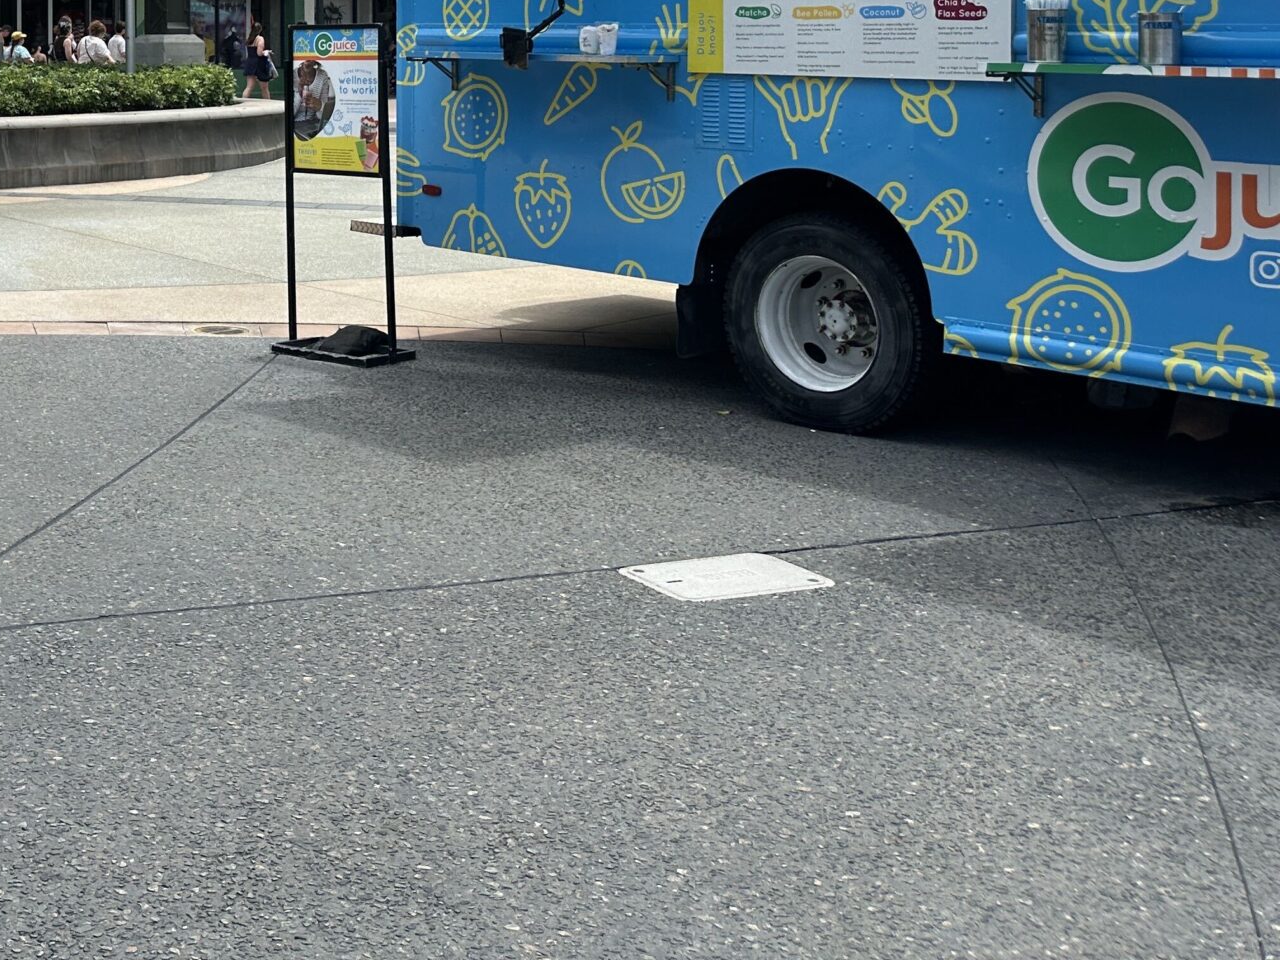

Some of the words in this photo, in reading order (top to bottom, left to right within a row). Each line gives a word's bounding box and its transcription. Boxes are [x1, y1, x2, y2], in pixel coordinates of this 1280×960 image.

[738, 9, 768, 17] Matcha
[796, 9, 811, 17] Bee
[813, 8, 838, 17] Pollen
[862, 7, 900, 17] Coconut
[937, 9, 956, 18] Flax
[958, 9, 987, 18] Seeds
[698, 12, 708, 33] you
[708, 15, 717, 56] know?!
[696, 36, 705, 55] Did
[339, 75, 378, 85] wellness
[339, 85, 348, 95] to
[351, 85, 377, 95] work!
